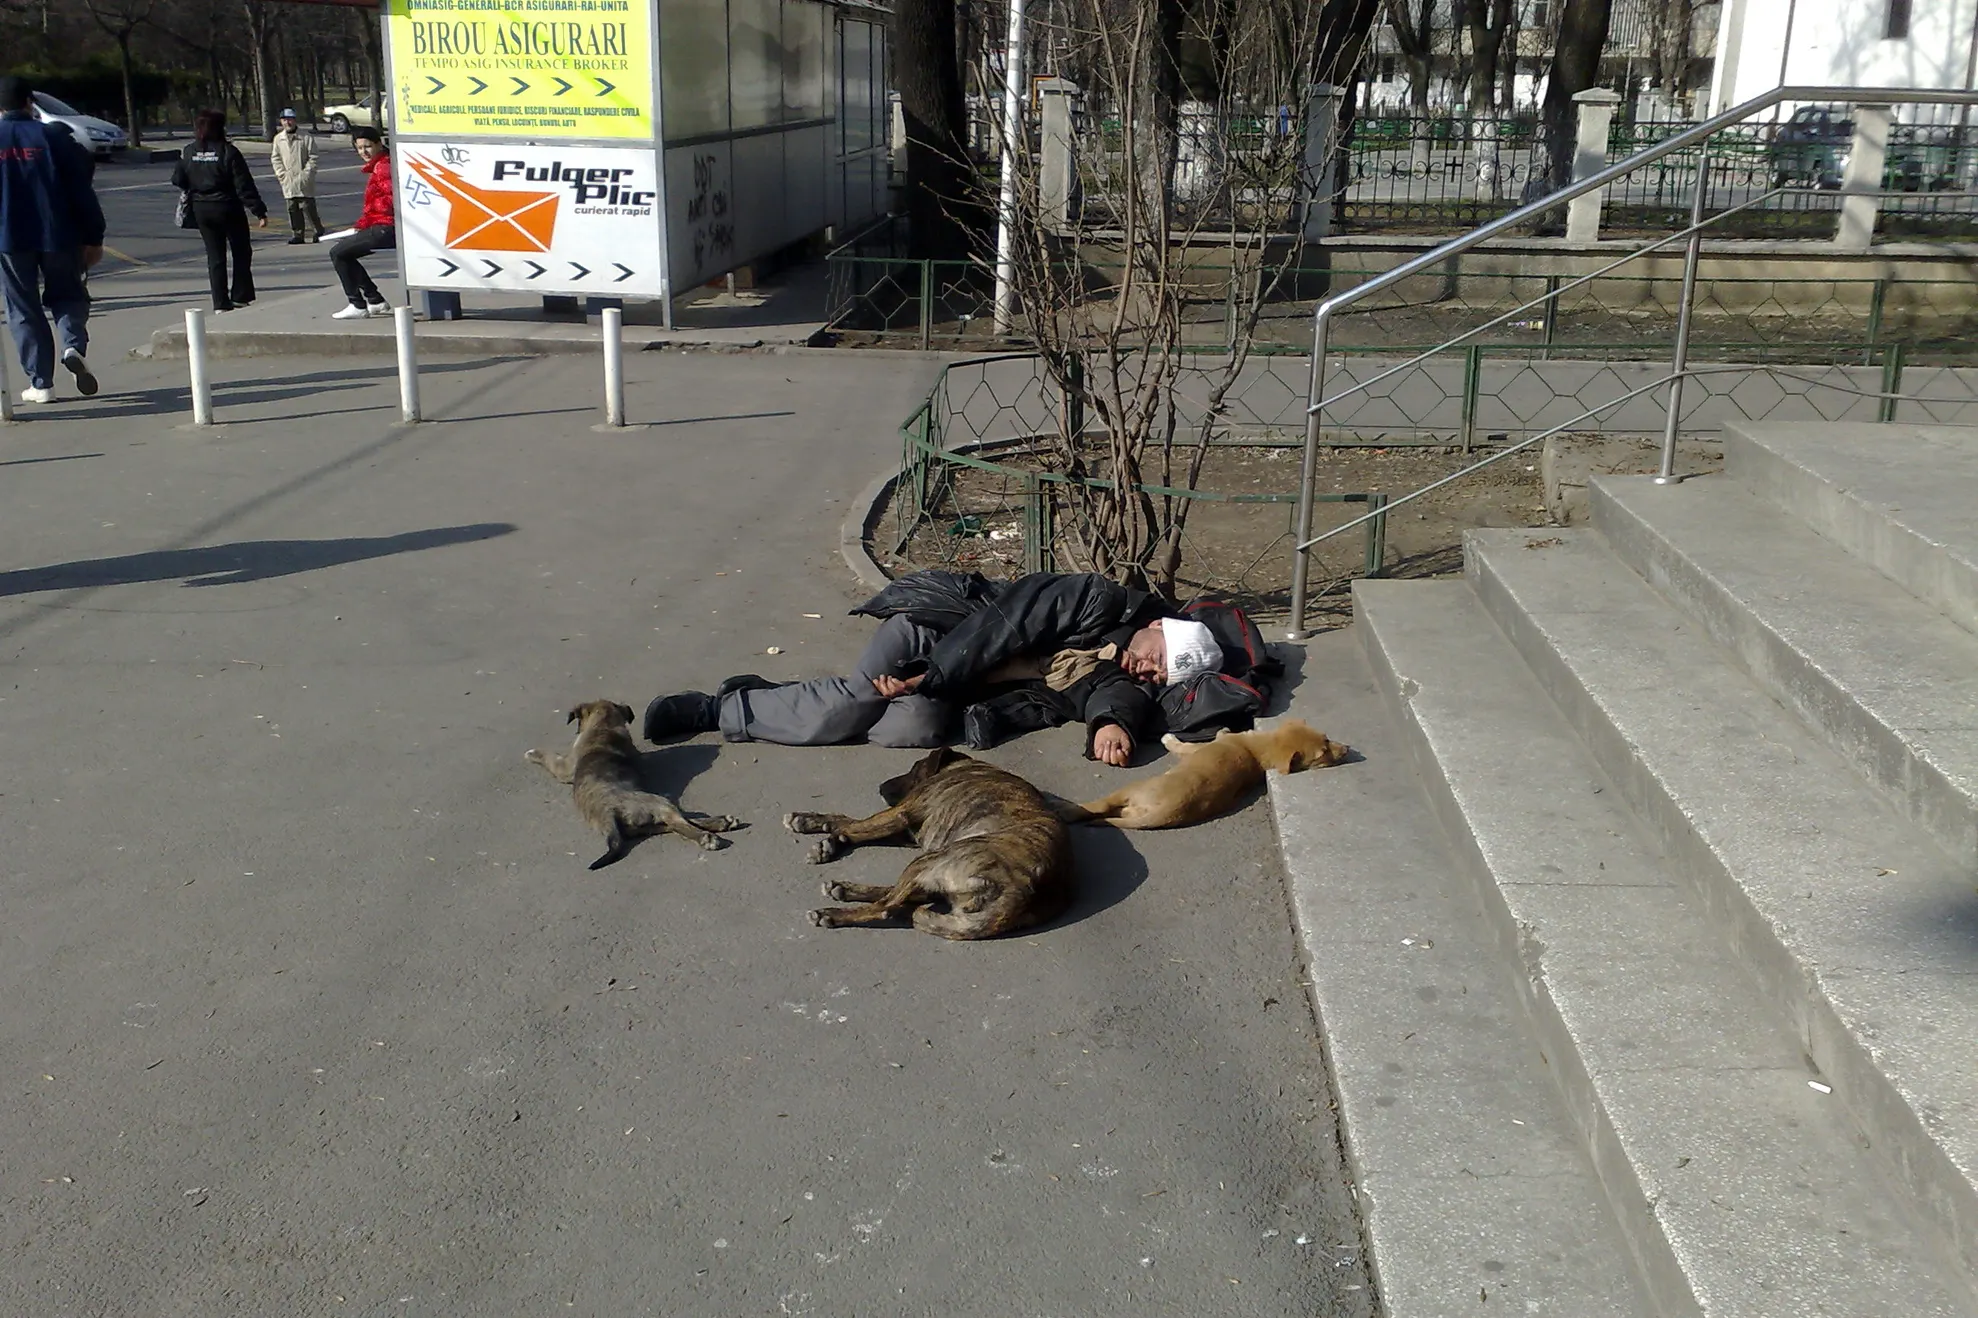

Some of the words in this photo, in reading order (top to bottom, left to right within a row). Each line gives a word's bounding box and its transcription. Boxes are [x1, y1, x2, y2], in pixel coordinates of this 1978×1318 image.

[411, 21, 486, 55] BIROU
[493, 21, 628, 56] ASIGURARI
[415, 58, 459, 69] TEMPO
[463, 58, 491, 69] ASIG
[496, 58, 570, 70] INSURANCE
[574, 59, 629, 70] BROKER
[492, 160, 634, 188] Fulger
[574, 184, 656, 206] Plic
[574, 206, 618, 215] curierat
[622, 207, 651, 216] rapid
